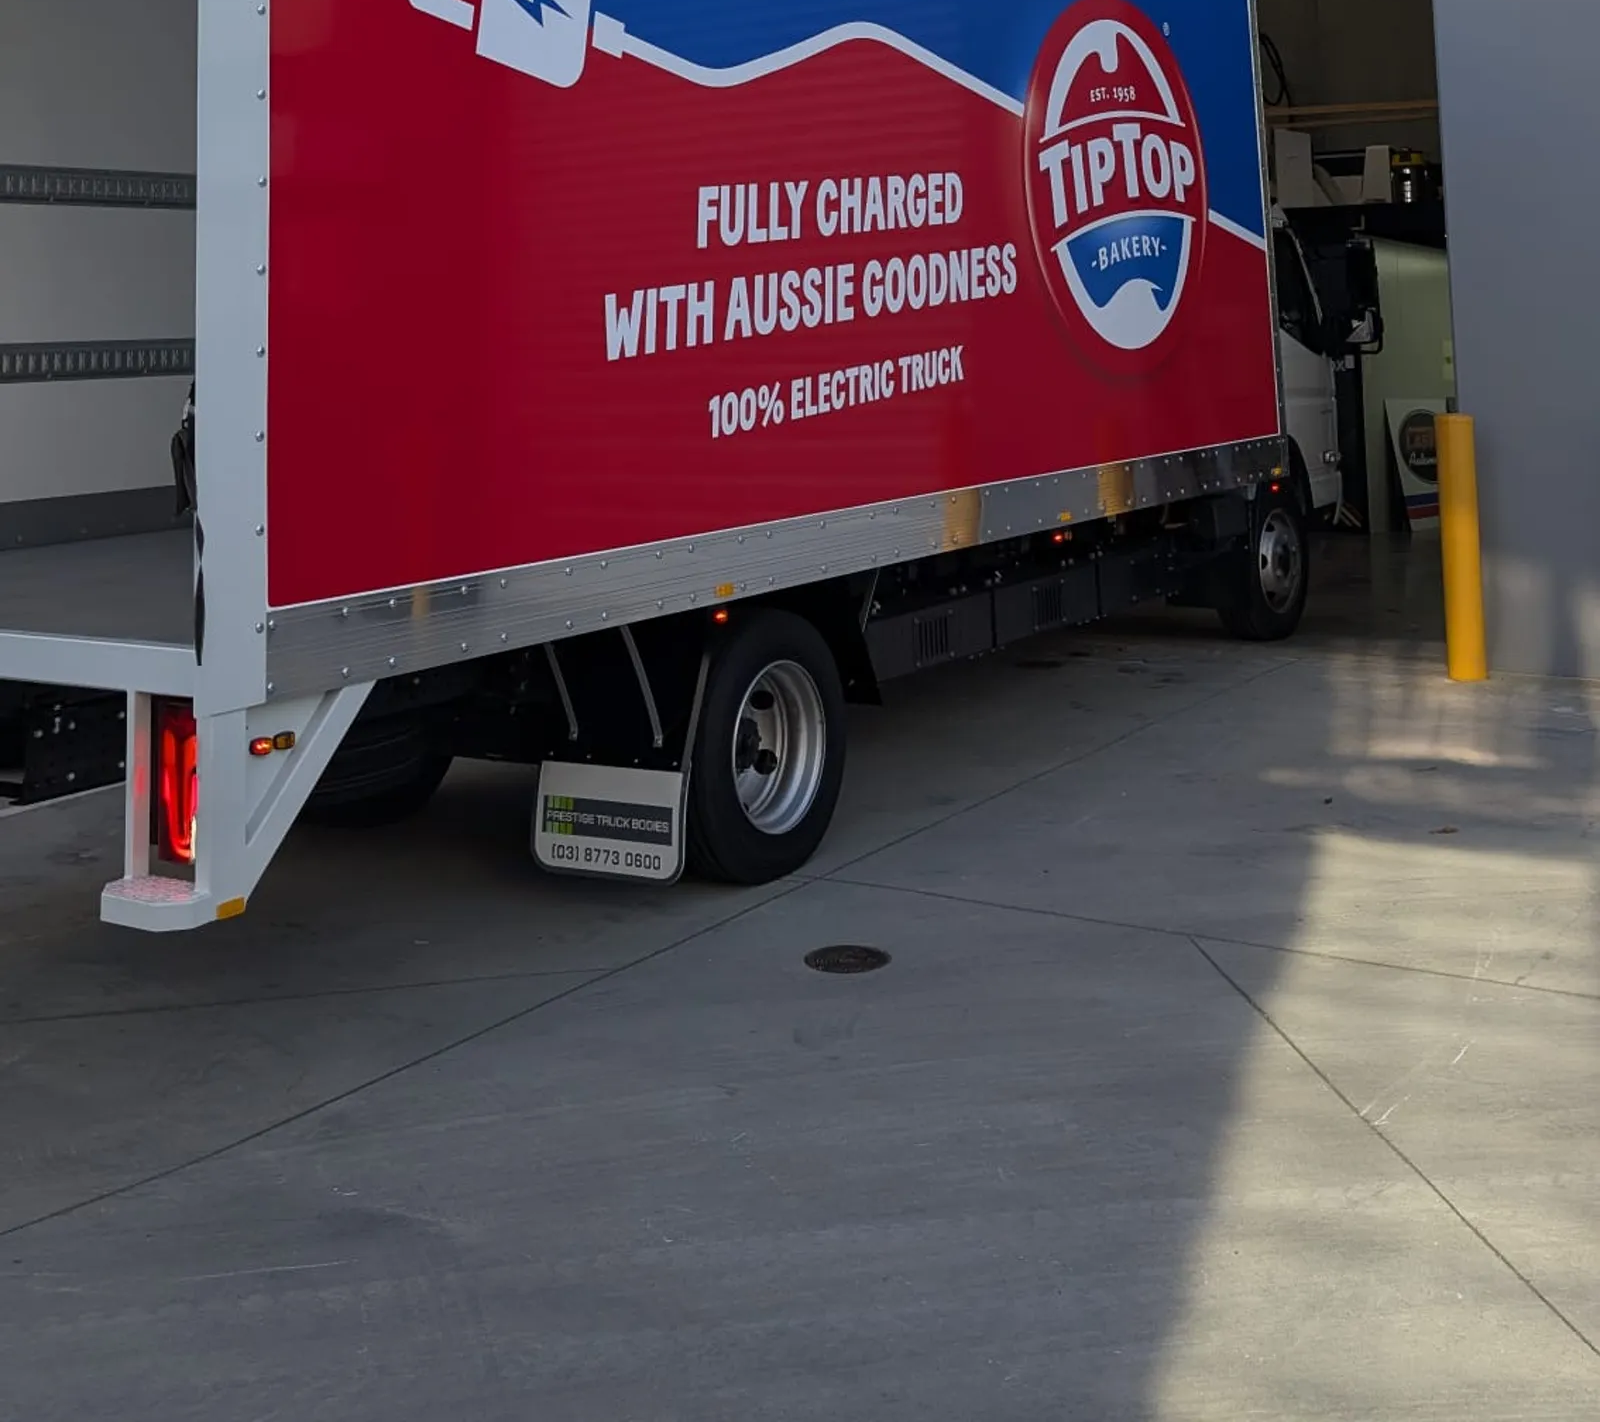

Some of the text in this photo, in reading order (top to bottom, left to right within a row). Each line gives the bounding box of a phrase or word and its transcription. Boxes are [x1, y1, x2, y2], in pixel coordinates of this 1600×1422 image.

[1090, 85, 1136, 103] EST. 1958
[697, 172, 963, 248] FULLY CHARGED
[604, 243, 1017, 361] WITH AUSSIE GOODNESS
[708, 346, 964, 438] 100% ELECTRIC TRUCK
[546, 809, 670, 833] PRESTIGE TRUCK BODIES
[552, 843, 661, 870] (03) 8773 0600
